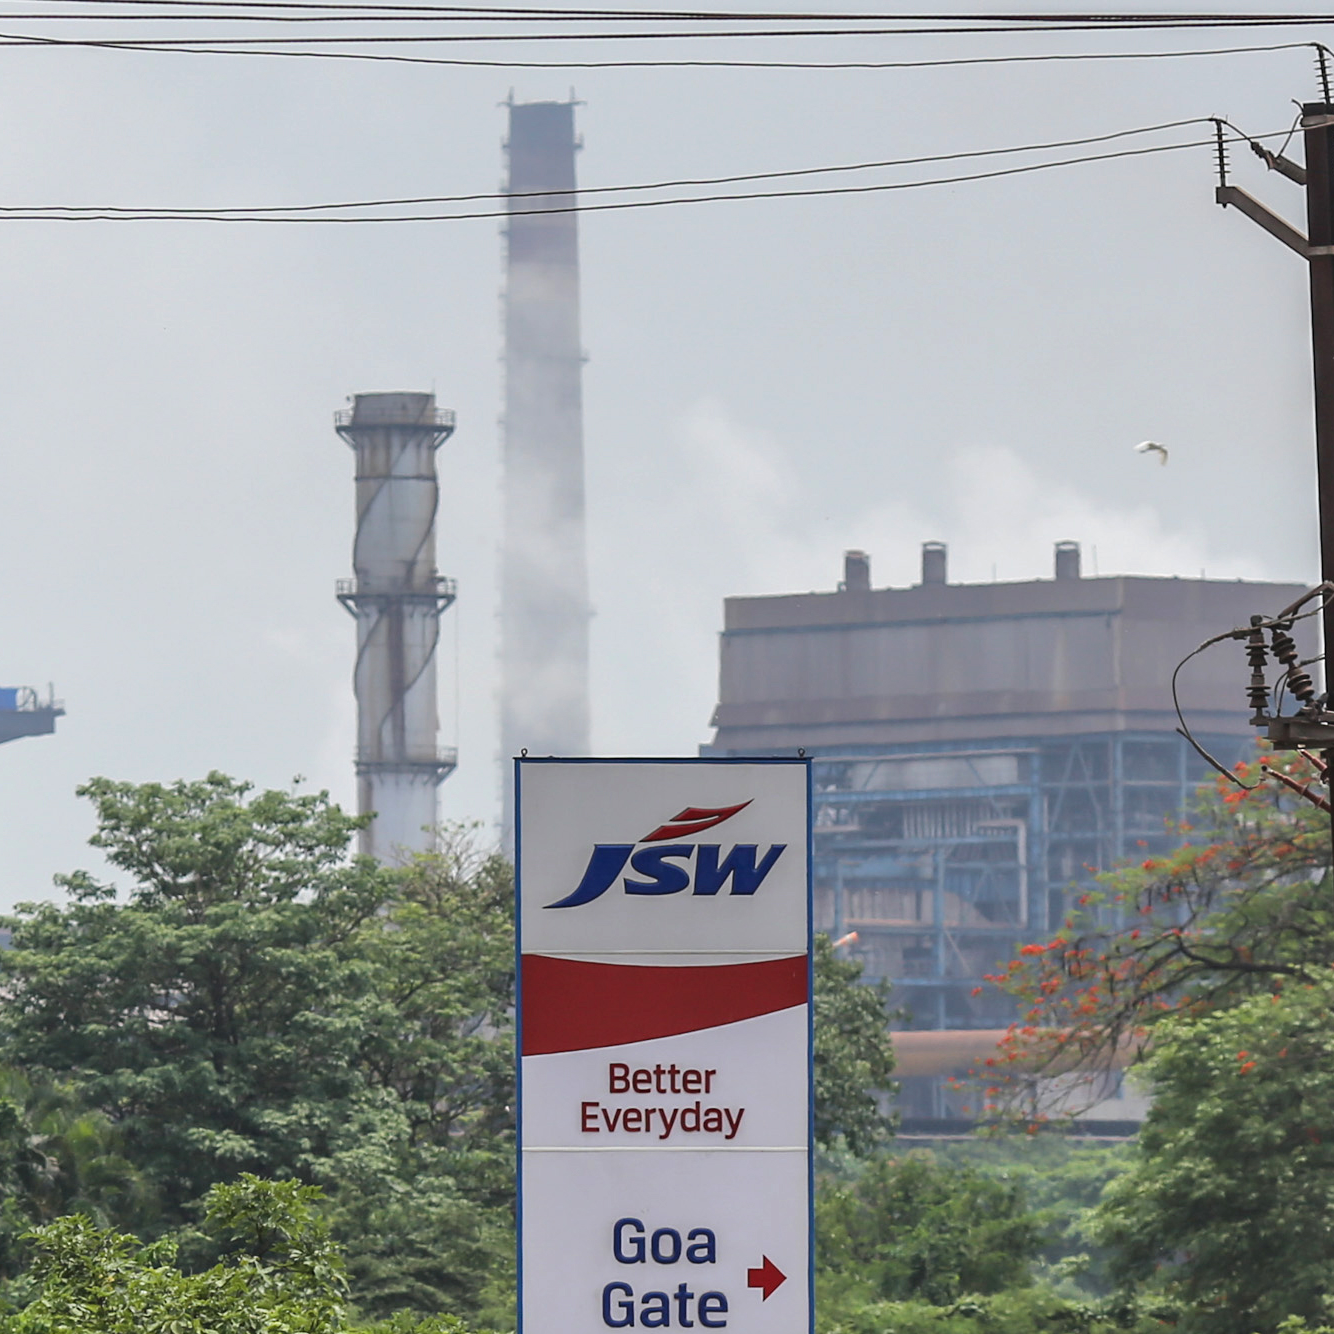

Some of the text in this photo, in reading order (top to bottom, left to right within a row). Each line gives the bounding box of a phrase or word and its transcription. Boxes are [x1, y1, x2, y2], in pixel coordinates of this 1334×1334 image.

[542, 843, 788, 909] JSW
[608, 1062, 717, 1095] Better
[580, 1100, 746, 1140] Everyday
[612, 1216, 717, 1265] Goa
[601, 1280, 730, 1329] Gate
